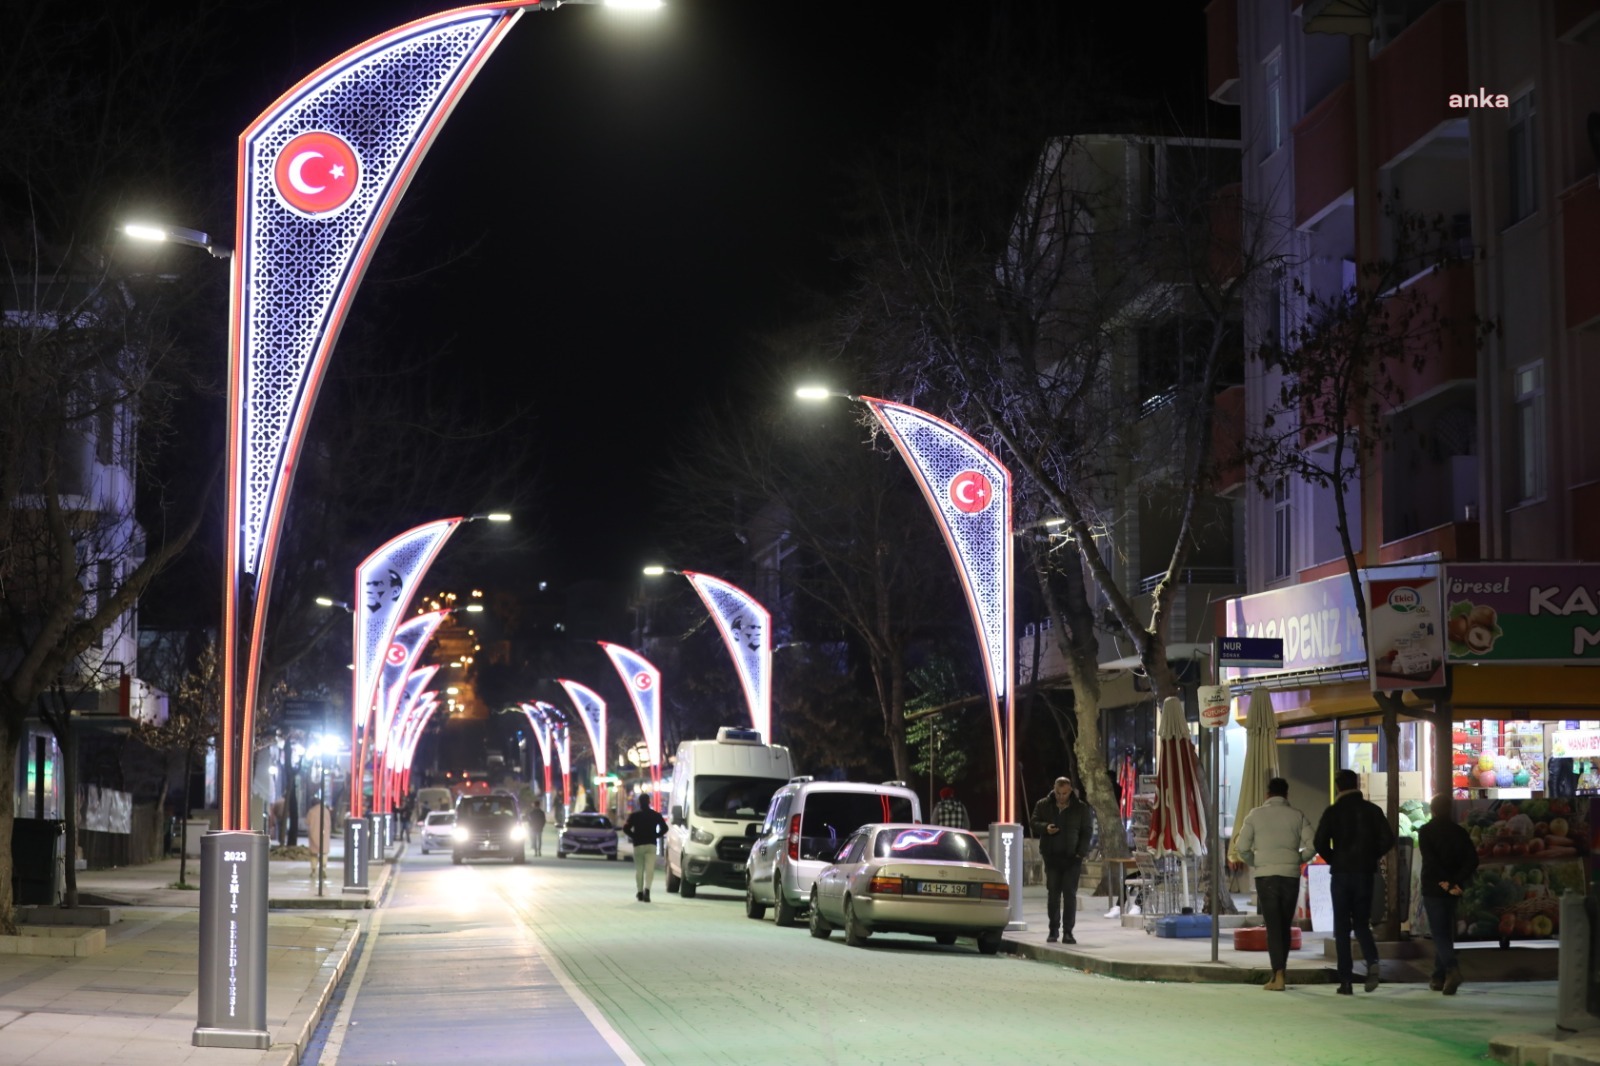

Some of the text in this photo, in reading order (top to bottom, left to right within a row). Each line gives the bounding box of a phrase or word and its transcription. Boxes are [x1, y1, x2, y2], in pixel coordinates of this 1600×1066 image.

[1394, 595, 1414, 603] Ekici
[1529, 586, 1600, 616] KA
[1223, 642, 1242, 651] NUR
[224, 851, 247, 862] 2023
[922, 883, 966, 893] 41 HZ 194
